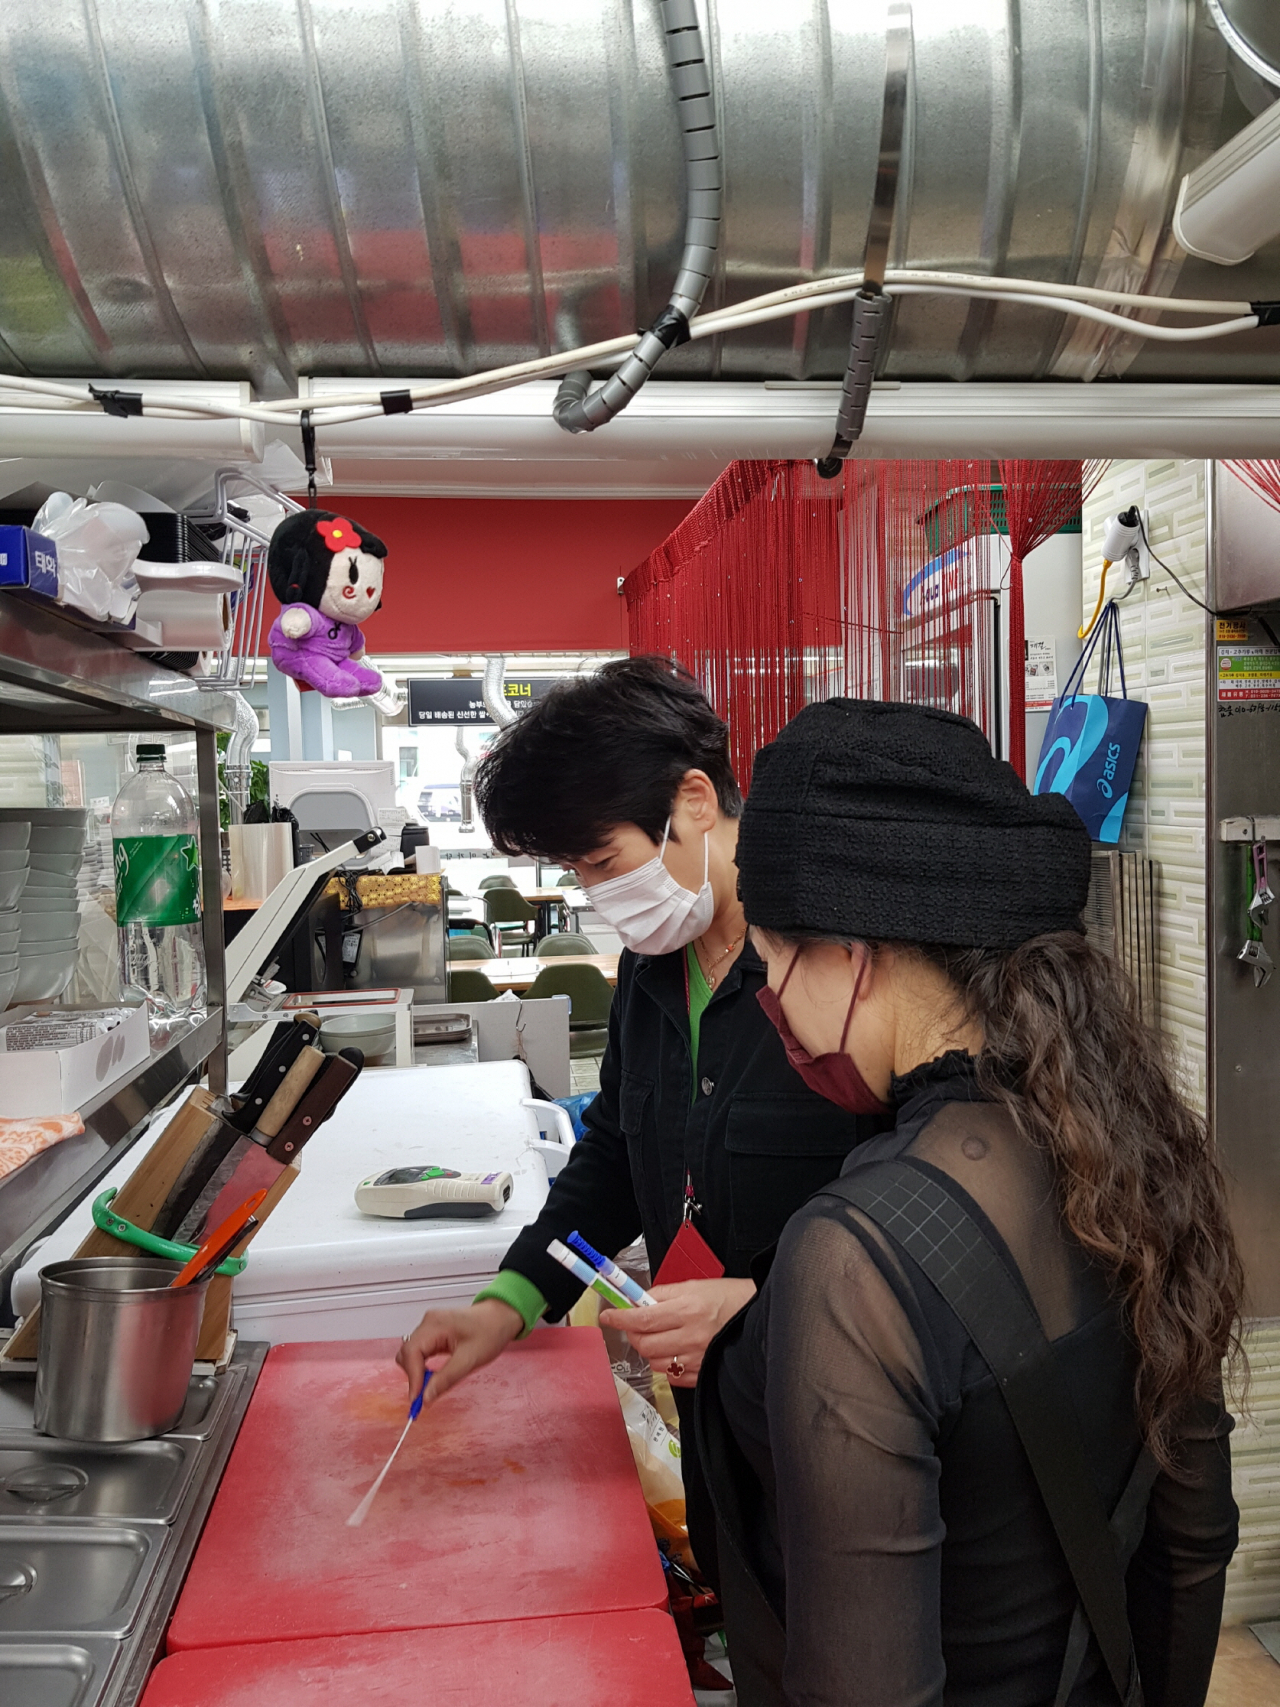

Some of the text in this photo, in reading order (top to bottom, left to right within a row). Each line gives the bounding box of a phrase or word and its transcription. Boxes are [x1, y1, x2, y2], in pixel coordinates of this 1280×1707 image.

[419, 711, 432, 719] 당일
[434, 711, 455, 719] 배송된
[457, 711, 477, 719] 신선한
[1103, 742, 1120, 780] asics
